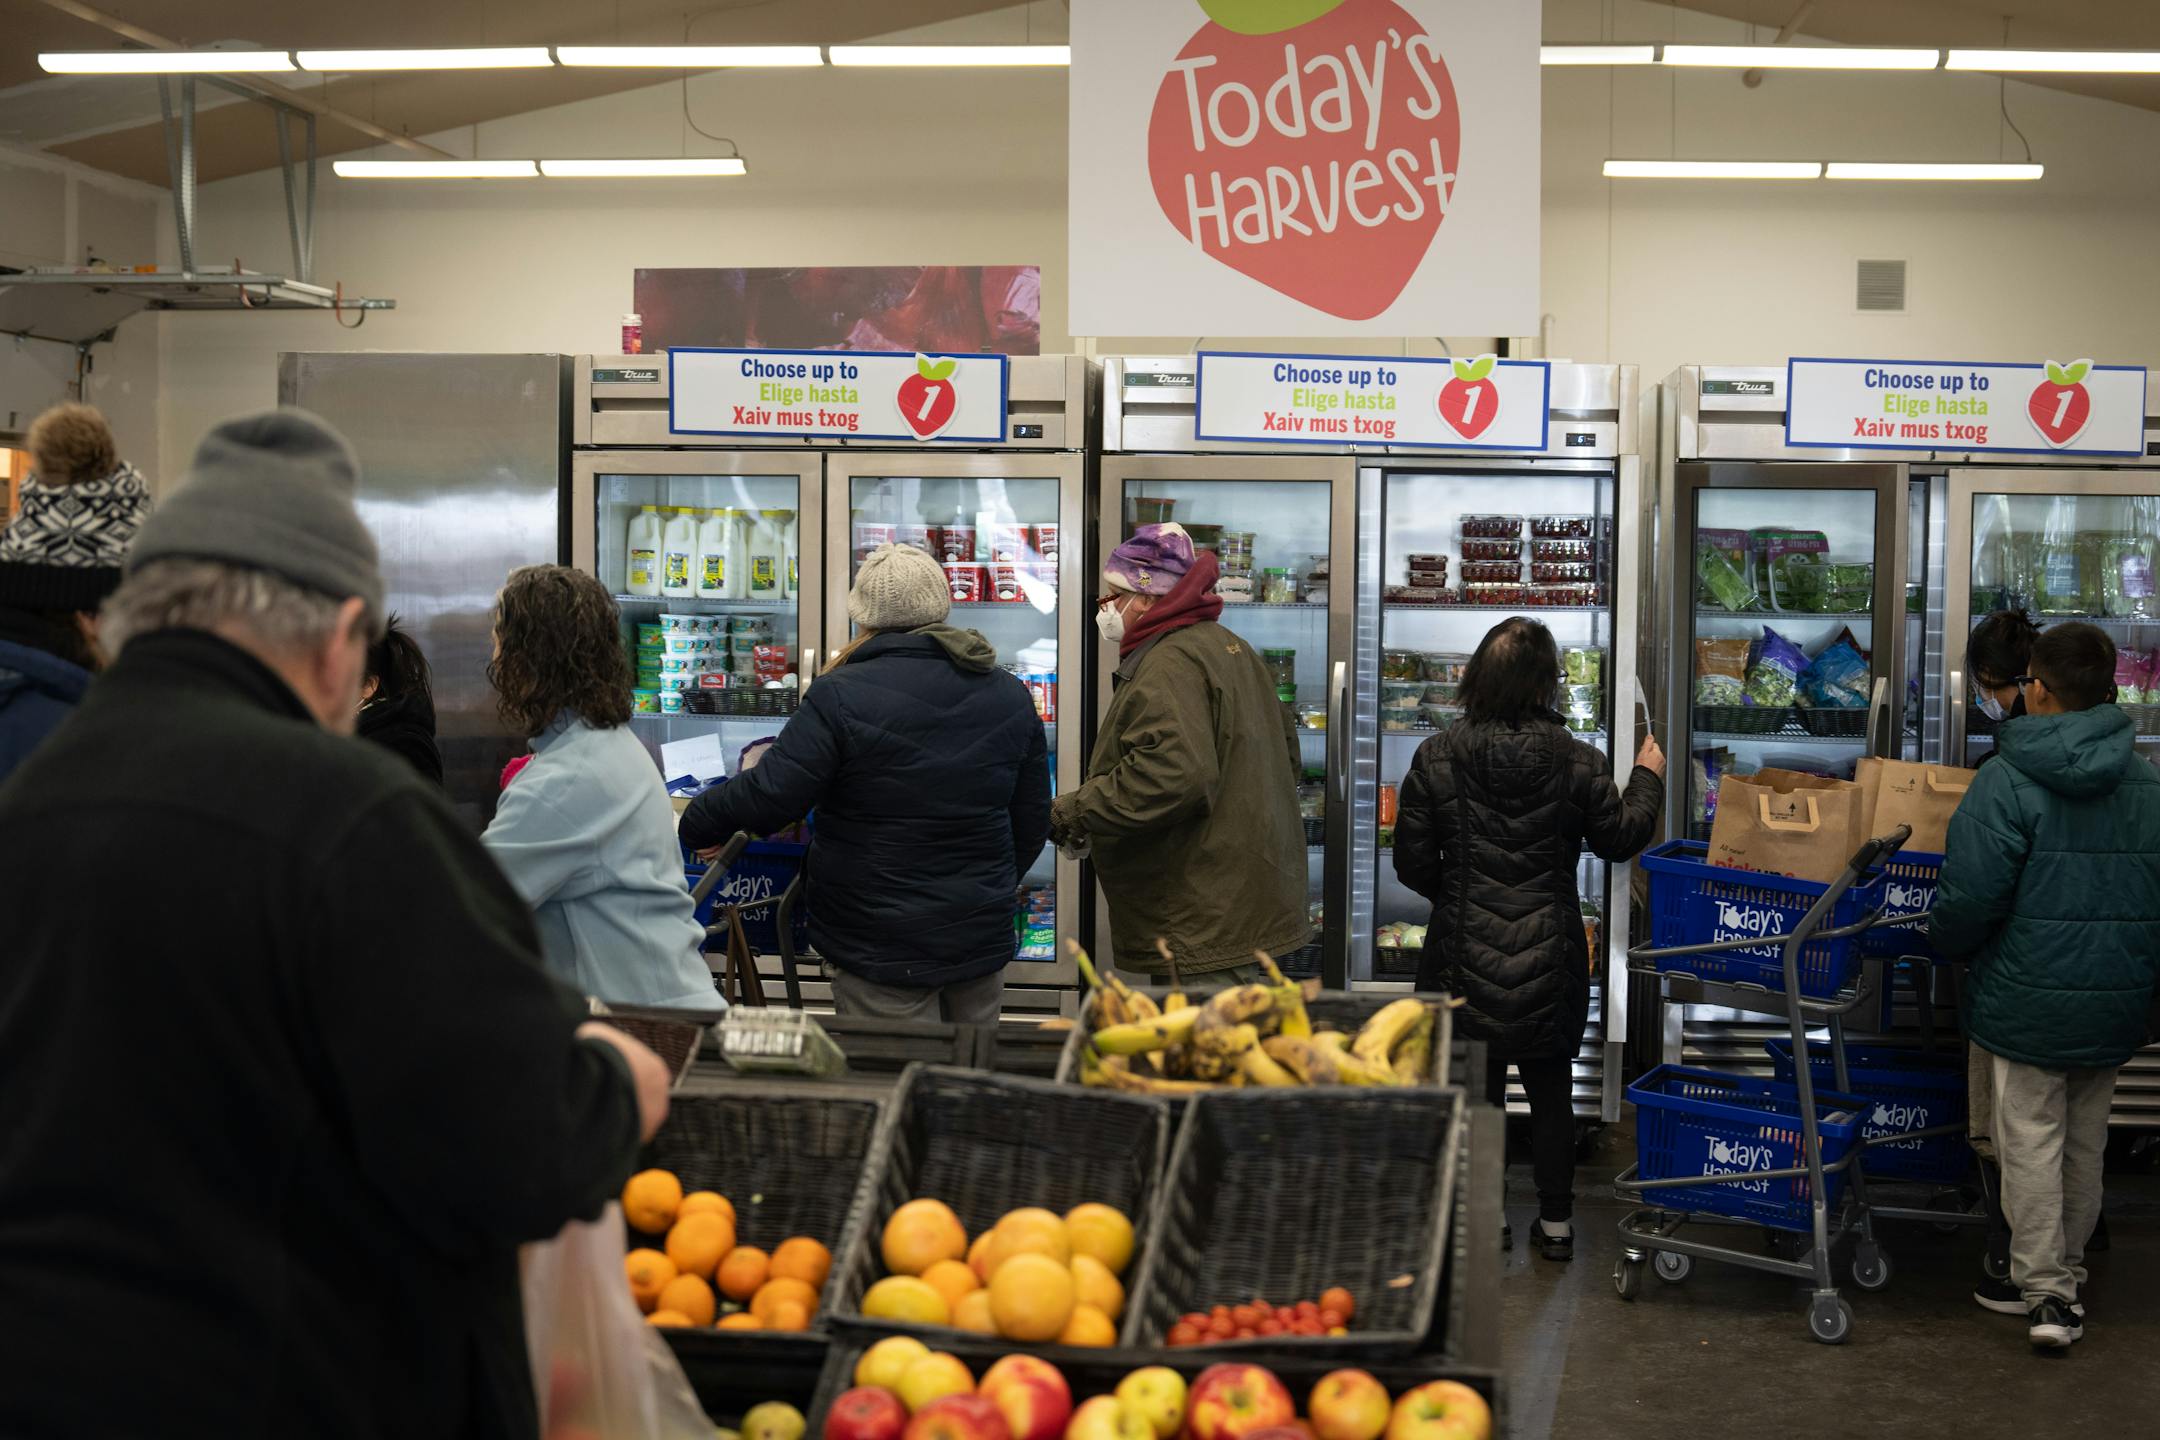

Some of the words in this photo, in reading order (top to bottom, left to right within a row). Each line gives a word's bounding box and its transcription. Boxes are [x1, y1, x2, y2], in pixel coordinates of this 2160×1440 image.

[1167, 28, 1442, 152] Today's
[741, 358, 806, 379] Choose
[812, 364, 834, 383] up
[839, 361, 858, 380] to
[1273, 363, 1342, 383] Choose
[1349, 369, 1371, 388] up
[1377, 367, 1397, 386] to
[1864, 368, 1934, 389] Choose
[1940, 374, 1963, 394] up
[1969, 372, 1989, 391] to
[760, 382, 804, 406] Elige
[809, 384, 858, 403] hasta
[917, 385, 942, 422] 1
[1292, 388, 1338, 412] Elige
[1344, 390, 1396, 410] hasta
[1461, 385, 1482, 425] 1
[1883, 393, 1929, 418] Elige
[1935, 395, 1988, 415] hasta
[733, 405, 771, 426] Xaiv
[776, 411, 813, 427] mus
[818, 409, 859, 432] txog
[2051, 390, 2074, 429] 1
[1263, 411, 1304, 432] Xaiv
[1310, 417, 1348, 433] mus
[1354, 415, 1396, 439] txog
[1853, 417, 1895, 437] Xaiv
[1900, 423, 1939, 439] mus
[1945, 421, 1988, 444] txog
[718, 873, 773, 902] day's
[1884, 882, 1938, 912] Today'
[1867, 1102, 1928, 1132] oday's
